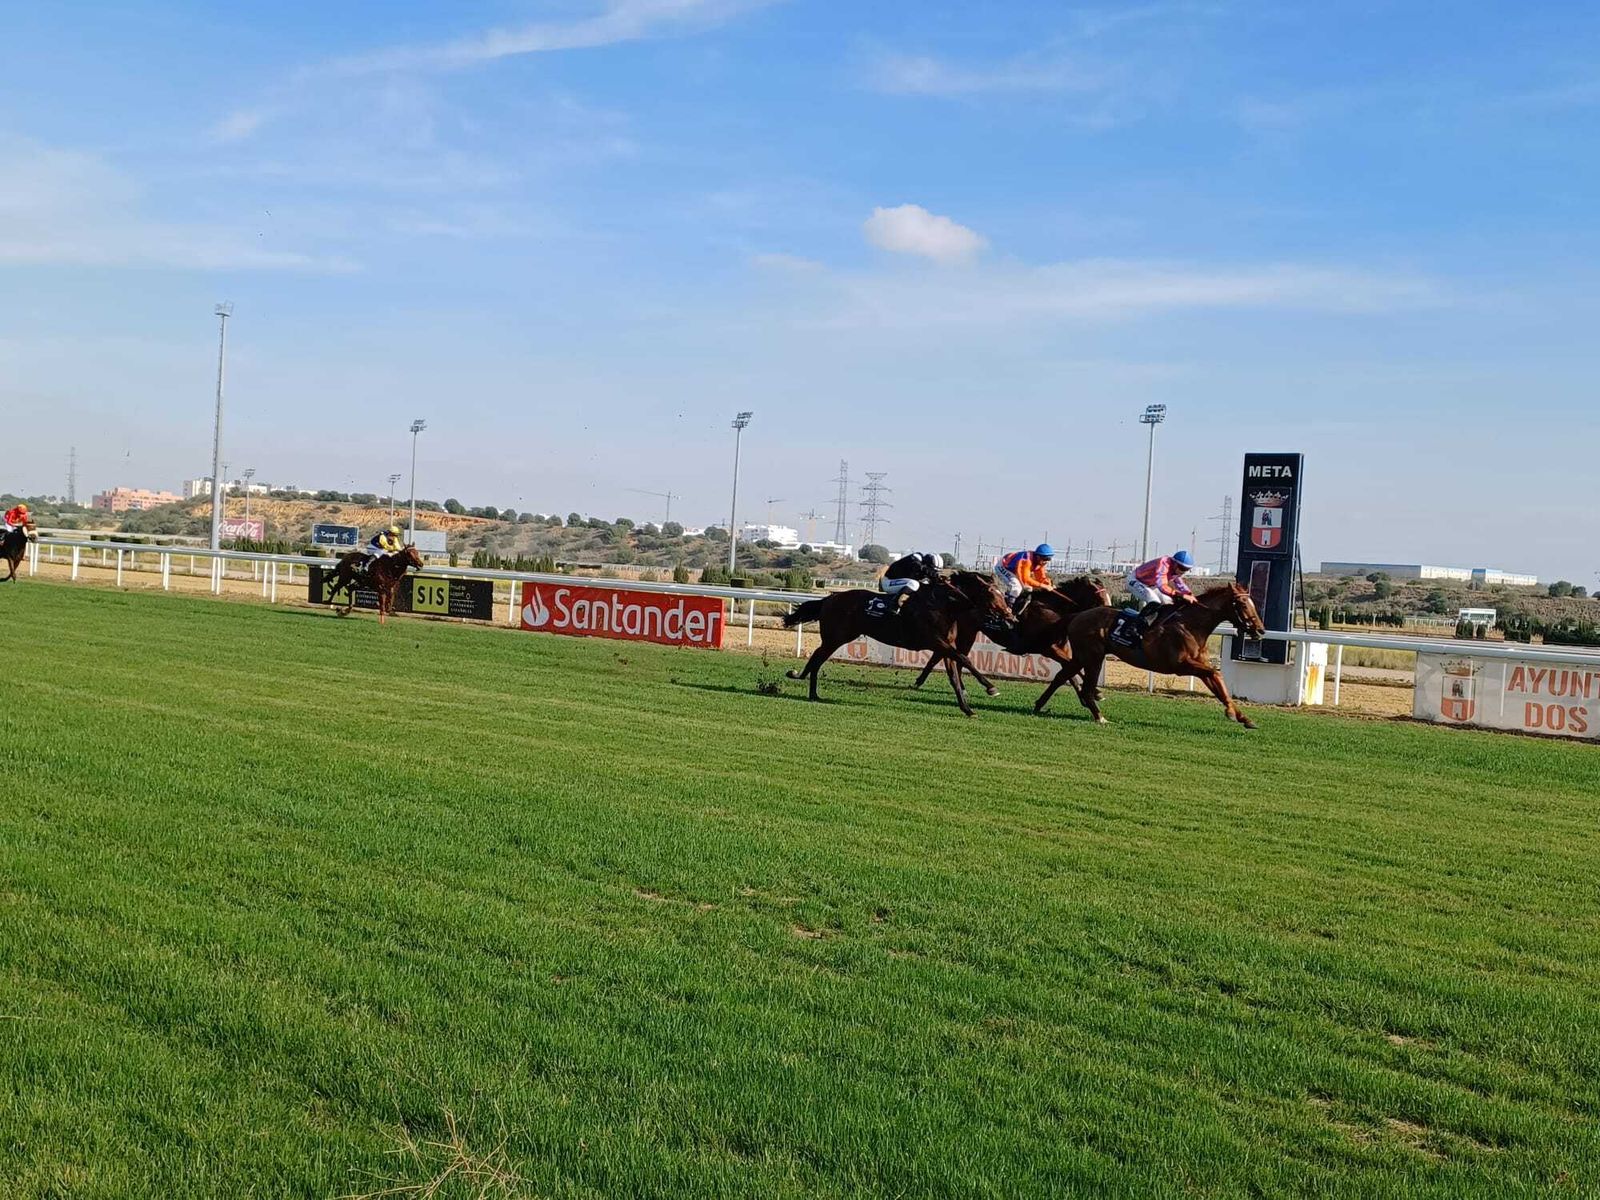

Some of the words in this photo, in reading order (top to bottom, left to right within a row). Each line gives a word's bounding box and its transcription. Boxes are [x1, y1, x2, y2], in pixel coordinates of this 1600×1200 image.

[1248, 465, 1293, 478] META
[416, 584, 446, 607] SIS
[553, 587, 721, 643] Santander
[1113, 618, 1126, 636] 2
[939, 647, 1052, 678] MANAS
[1525, 702, 1589, 733] DOS
